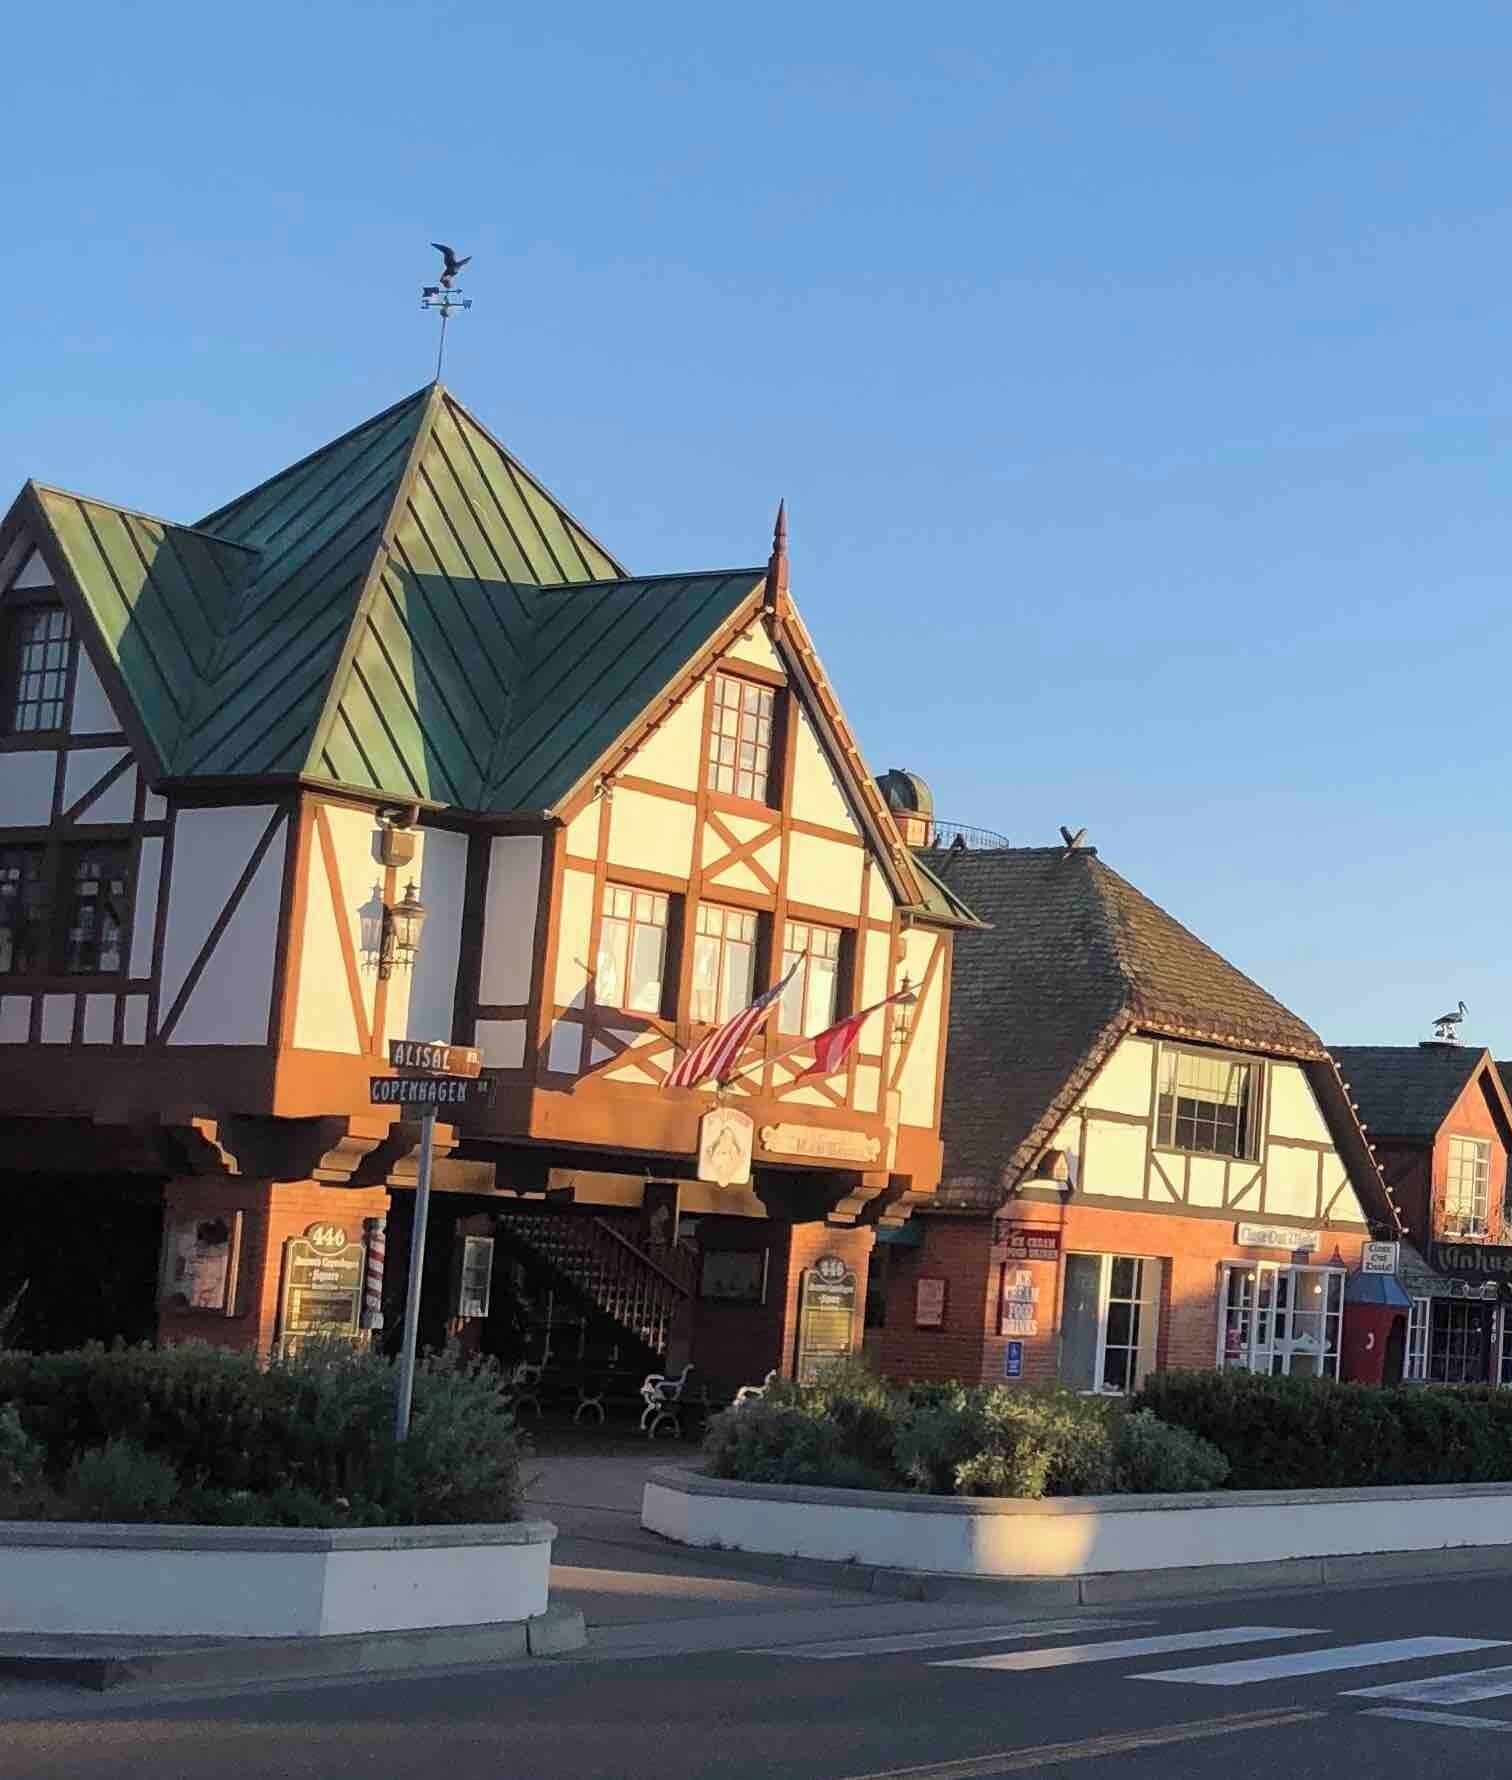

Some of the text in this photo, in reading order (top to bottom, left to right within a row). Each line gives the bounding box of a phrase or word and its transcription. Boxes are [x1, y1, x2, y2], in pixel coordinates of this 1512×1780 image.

[394, 1043, 451, 1071] ALISAL
[372, 1080, 467, 1102] COPENHAGEN
[313, 1226, 345, 1247] 446
